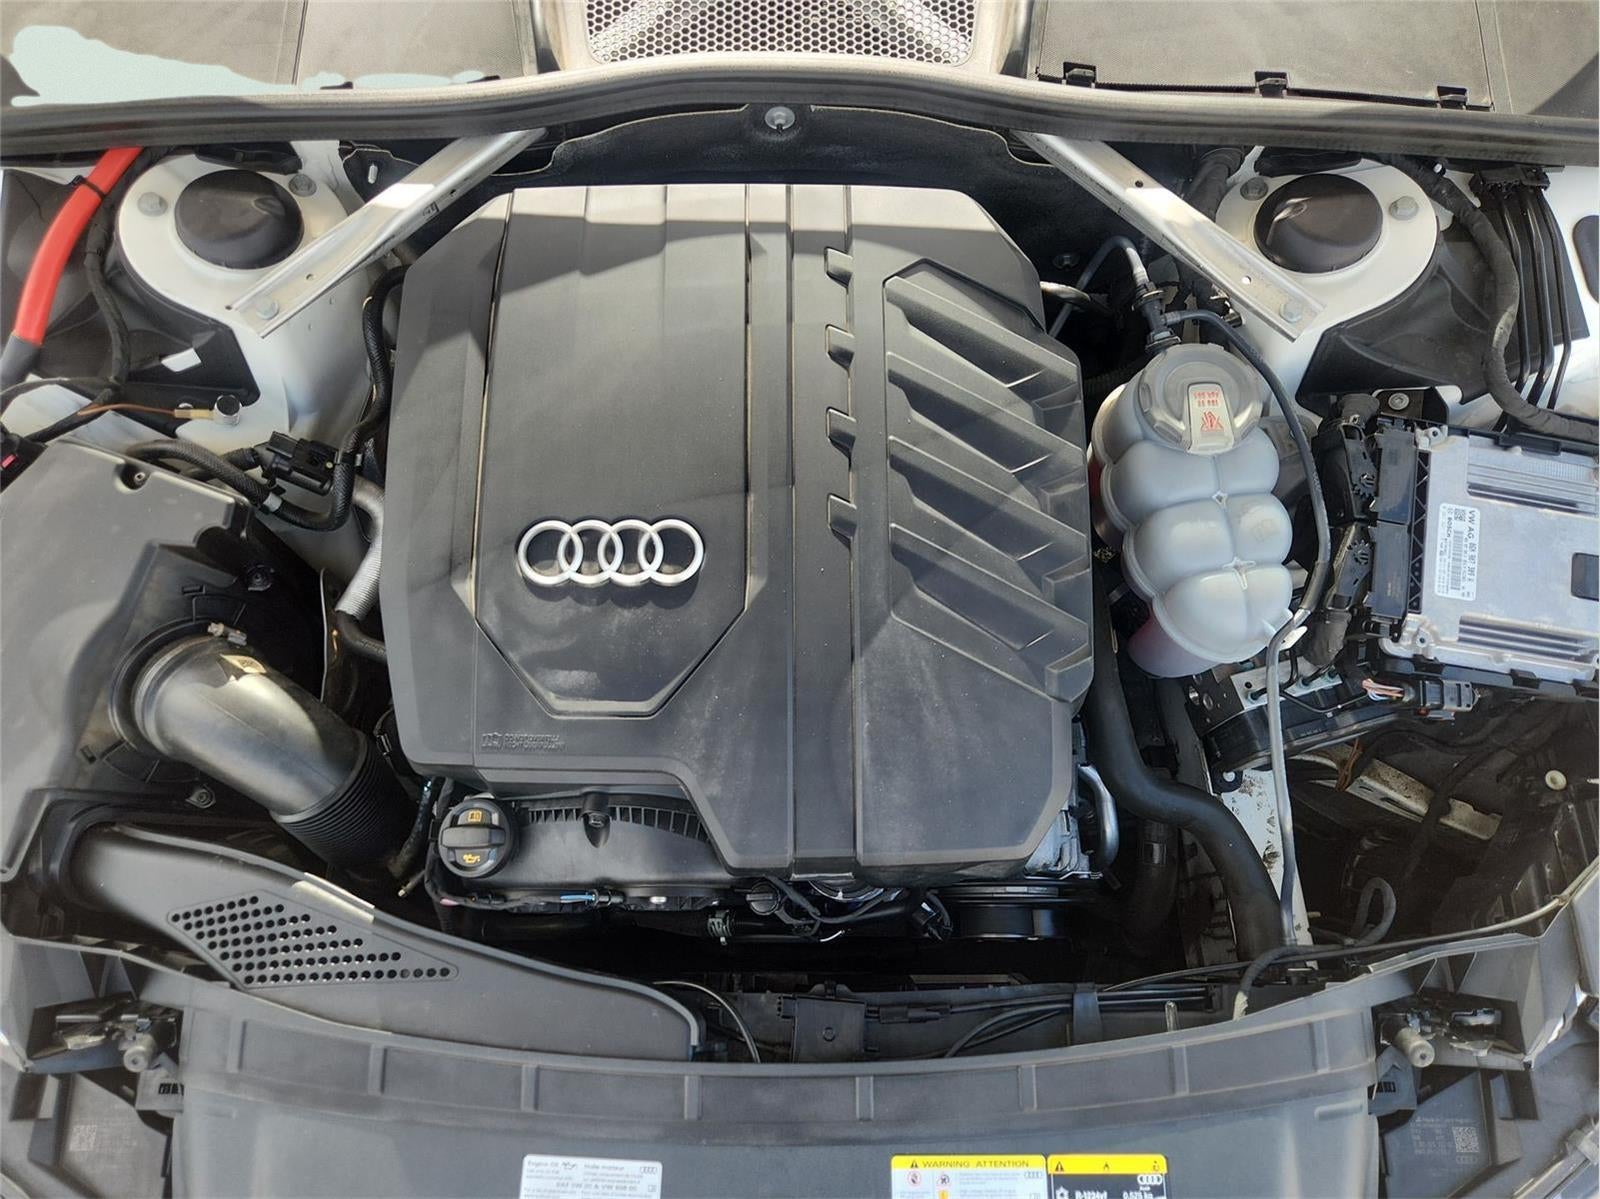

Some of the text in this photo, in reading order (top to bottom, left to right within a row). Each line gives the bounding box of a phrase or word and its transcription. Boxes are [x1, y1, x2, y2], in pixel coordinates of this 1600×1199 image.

[1468, 510, 1476, 524] VW
[1467, 526, 1475, 540] AG
[922, 1160, 1030, 1168] WARNING ATTENTION
